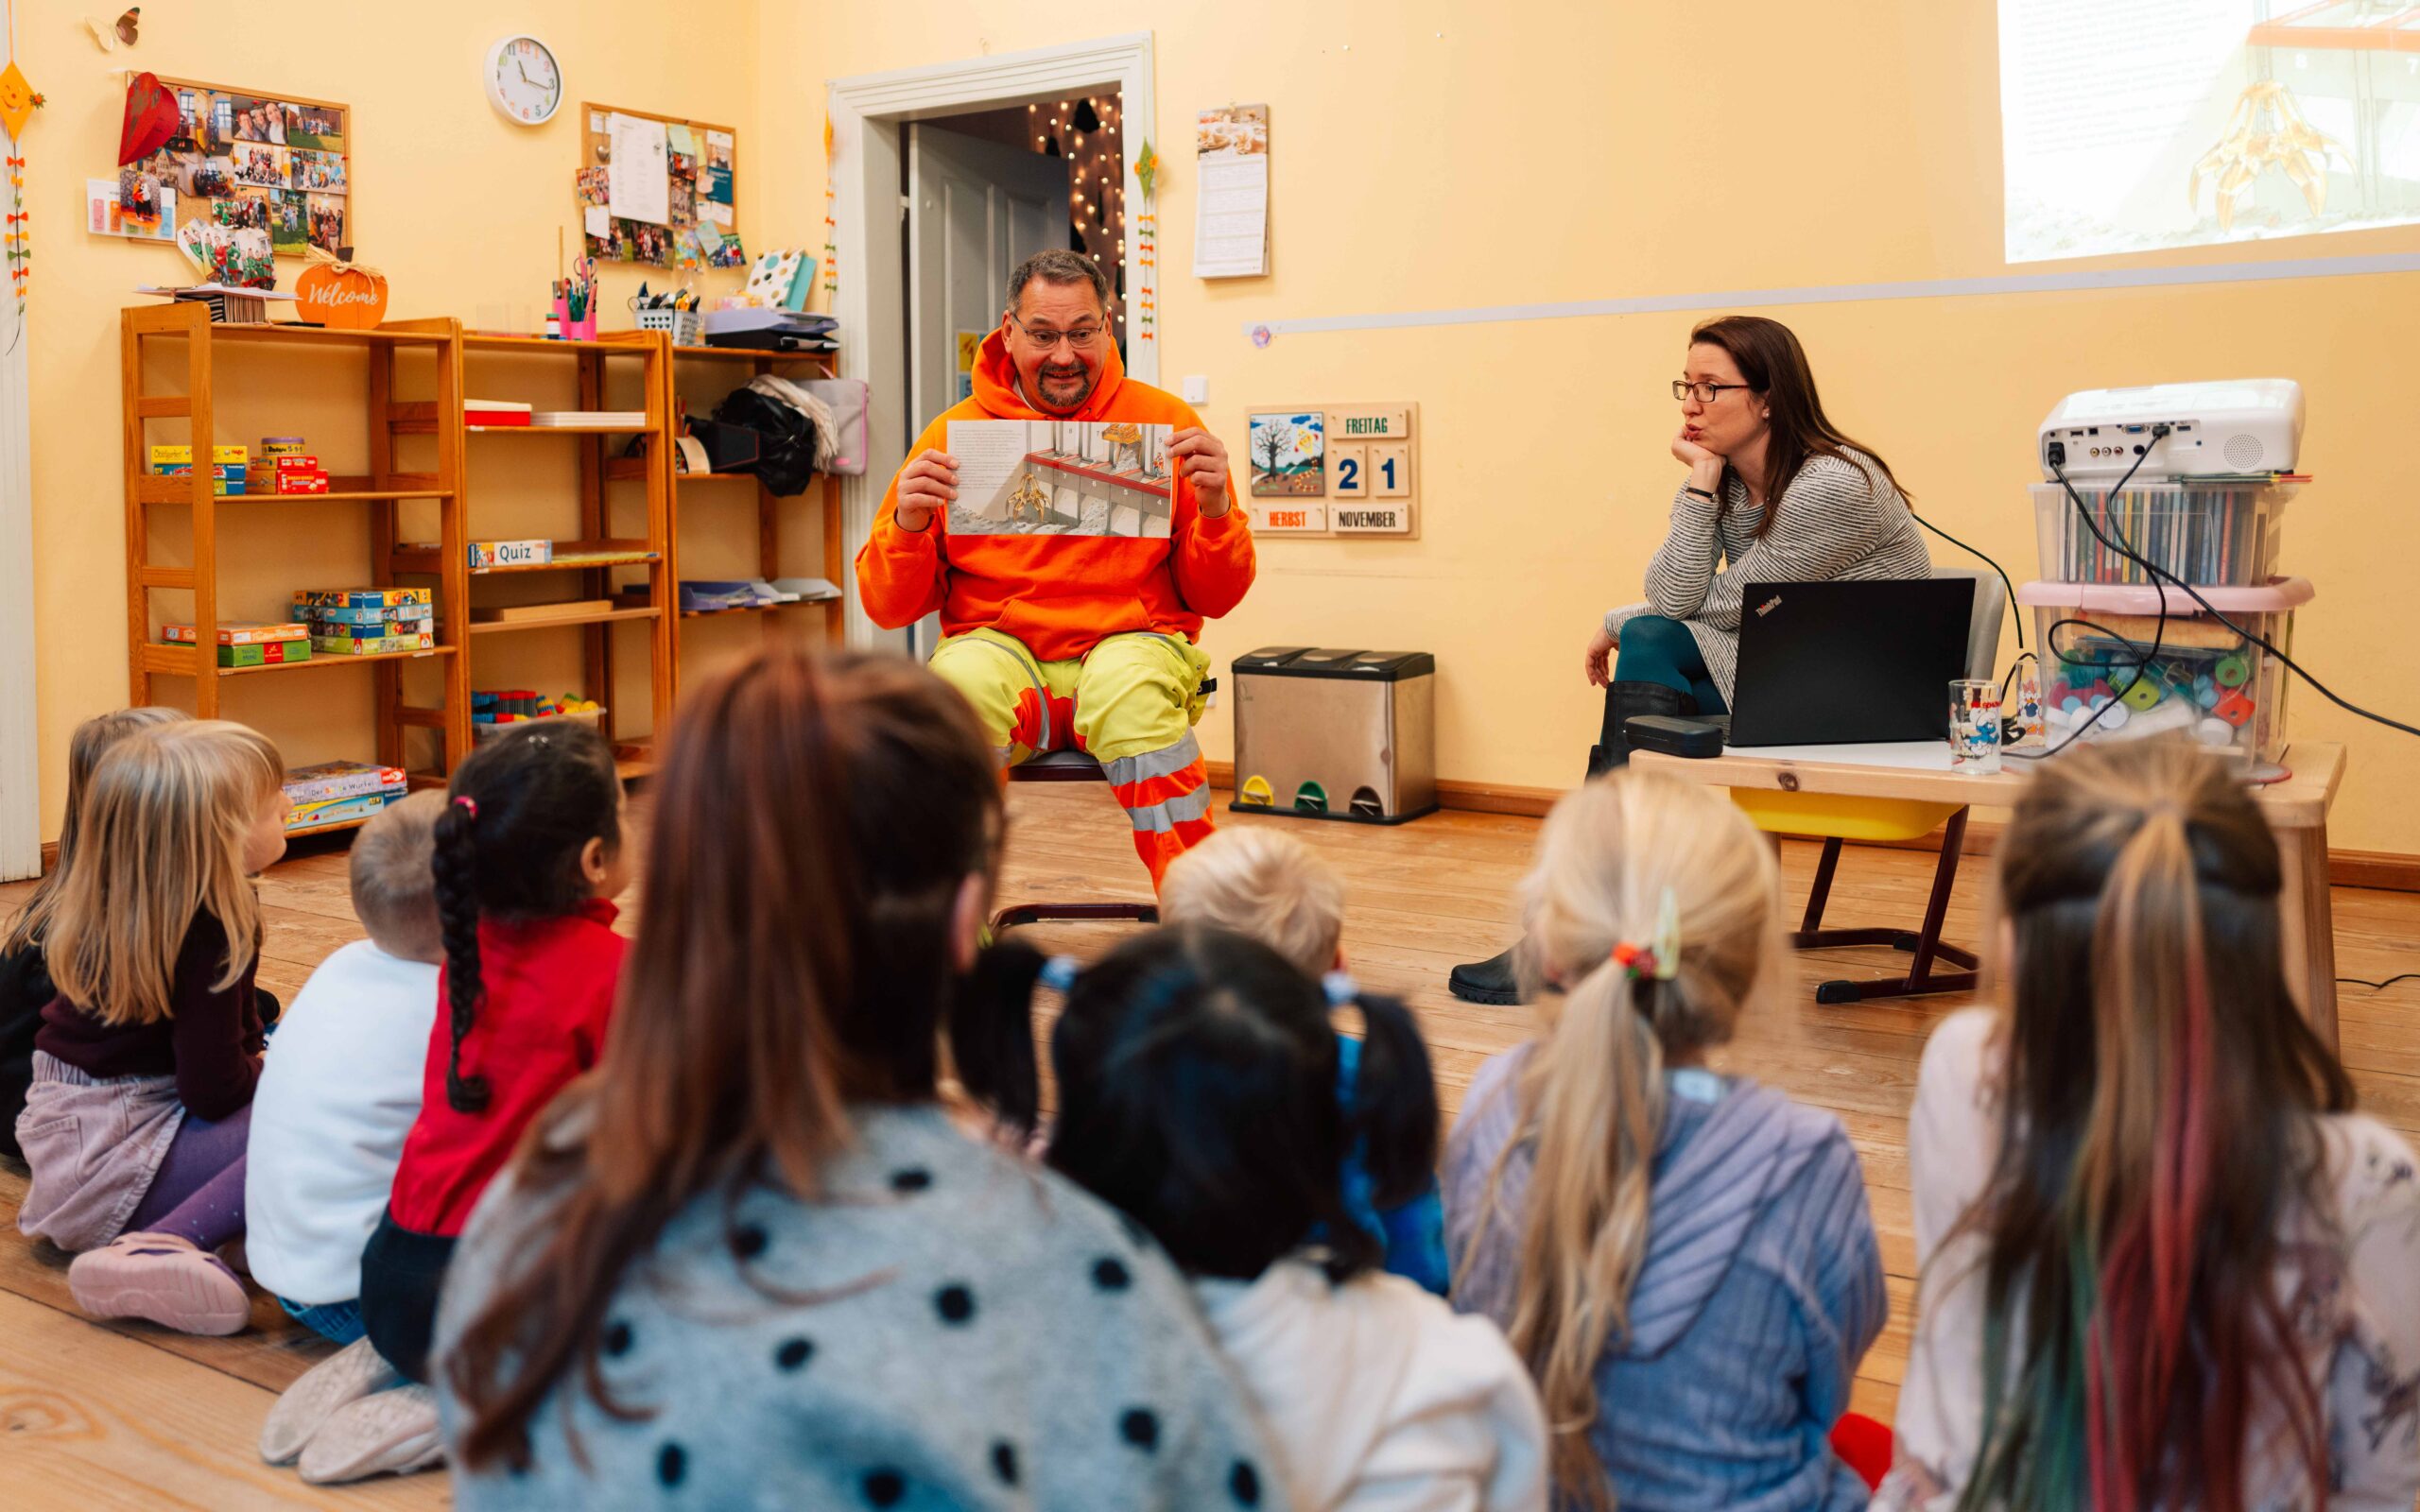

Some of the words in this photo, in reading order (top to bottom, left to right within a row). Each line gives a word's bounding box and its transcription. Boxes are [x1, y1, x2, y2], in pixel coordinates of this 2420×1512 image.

[508, 43, 516, 56] 11
[519, 41, 529, 55] 12
[2294, 53, 2308, 70] 8
[2407, 58, 2418, 75] 7
[548, 77, 555, 90] 3
[522, 107, 529, 120] 6
[535, 106, 542, 116] 5
[308, 282, 378, 307] Welcome
[1346, 417, 1388, 435] FREITAG
[1339, 458, 1358, 490] 2
[1381, 457, 1395, 490] 1
[1269, 511, 1306, 527] HERBST
[1339, 511, 1396, 528] NOVEMBER
[499, 542, 531, 563] Quiz
[1755, 594, 1783, 617] ThinkPad
